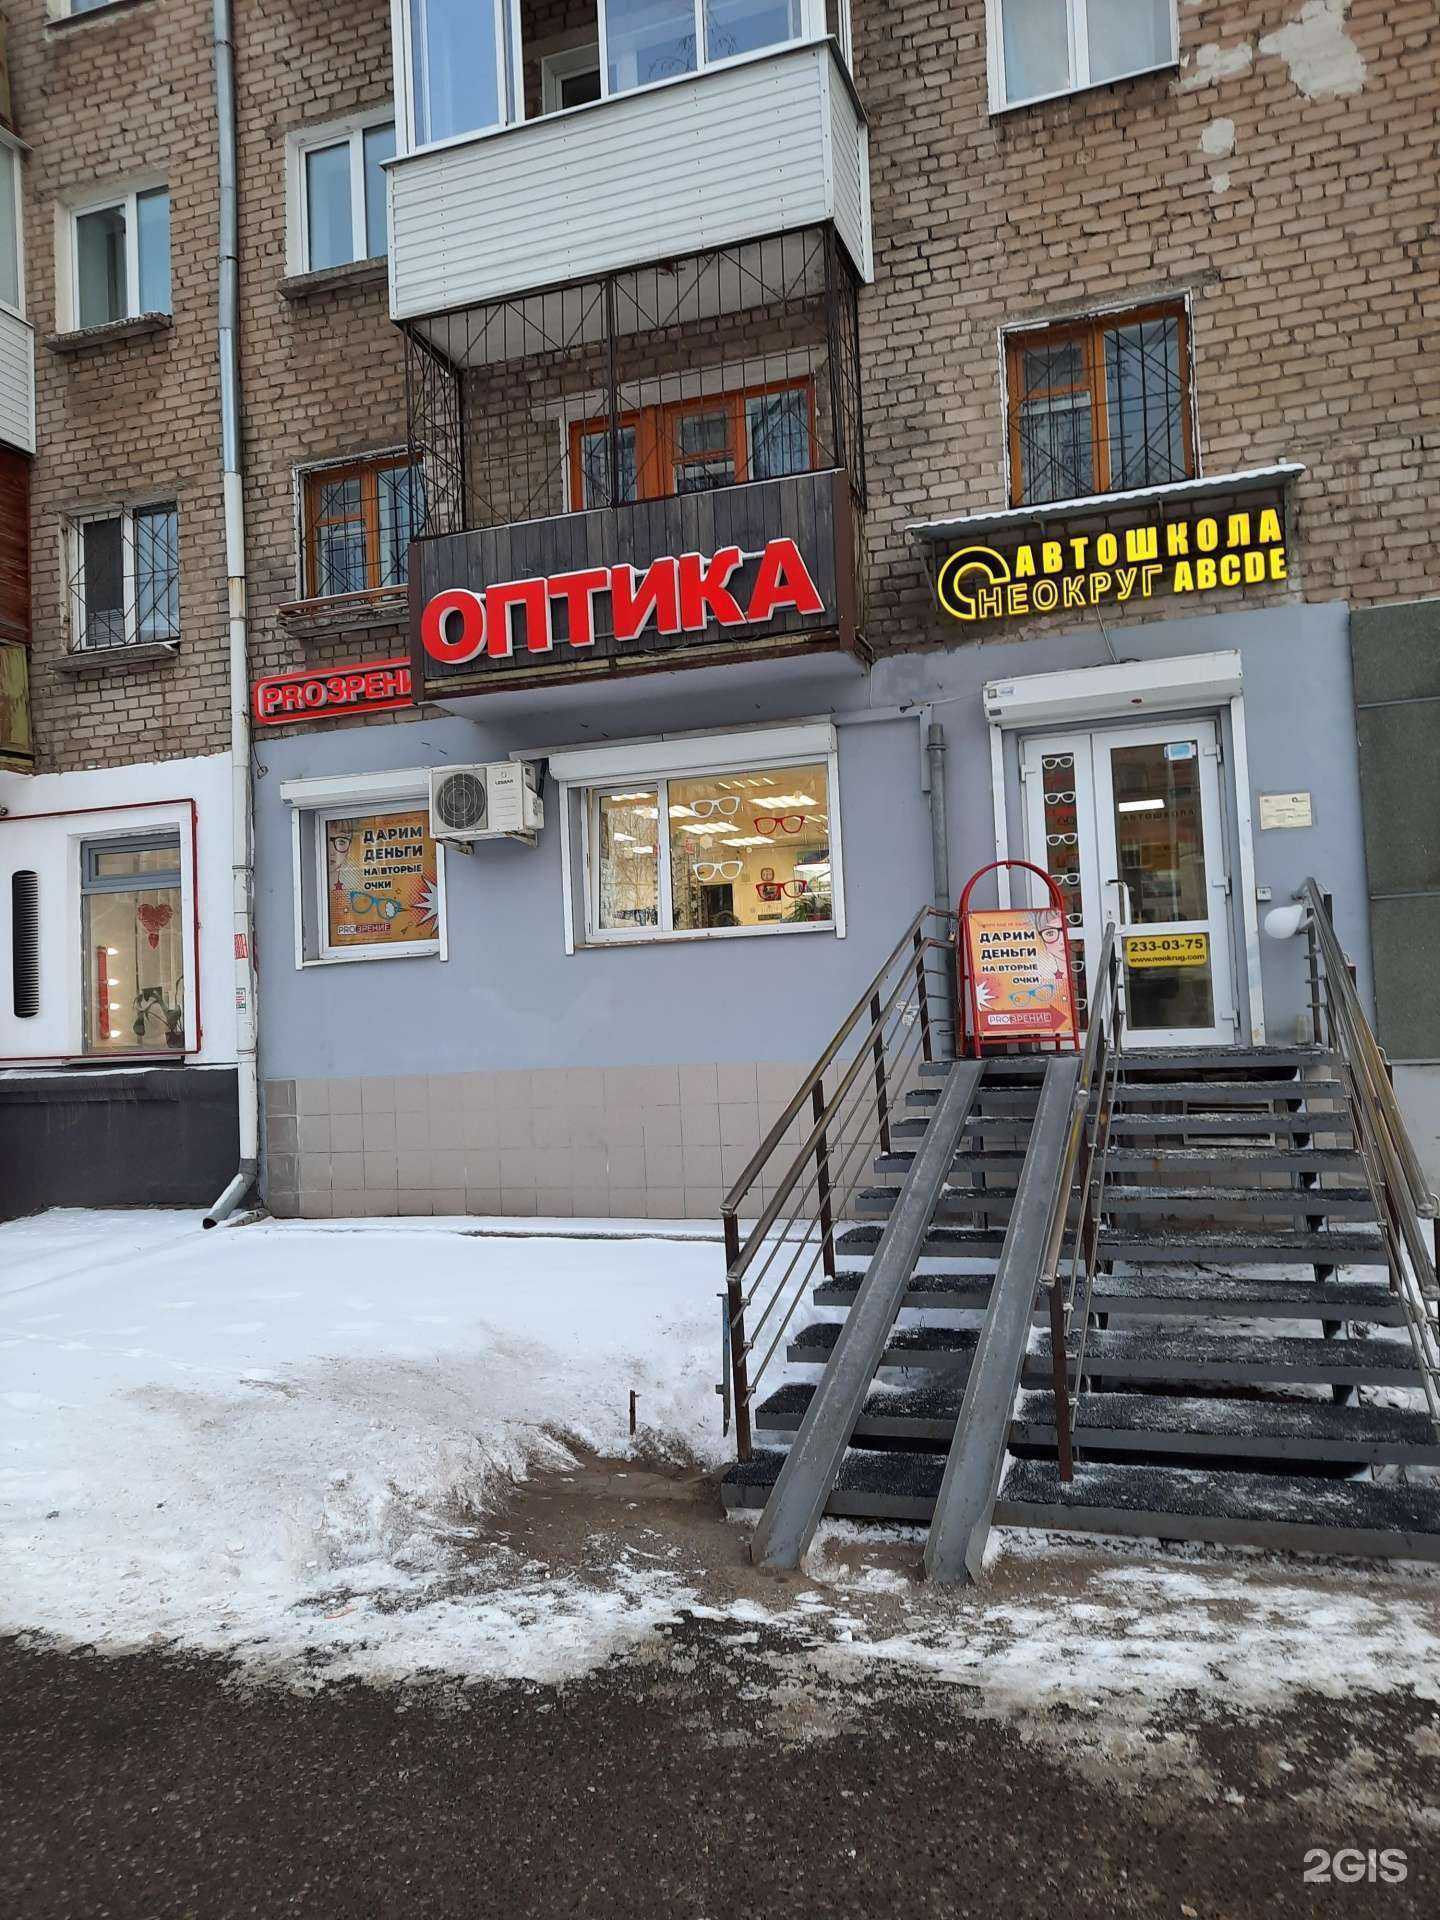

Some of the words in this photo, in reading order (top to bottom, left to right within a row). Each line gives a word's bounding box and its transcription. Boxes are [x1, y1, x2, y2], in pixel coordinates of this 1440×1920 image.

[1015, 509, 1282, 578] АВТОШКОЛА
[979, 564, 1163, 619] НЕОКРУГ
[420, 537, 825, 664] ОПТИКА
[363, 826, 423, 844] ДАРИМ
[363, 845, 423, 863] ДЕНЬГИ
[364, 867, 379, 876] НА
[381, 864, 422, 875] ВТОРЫЕ
[364, 880, 392, 890] ОЧКИ
[980, 931, 1035, 943] ДАРИМ
[1130, 938, 1204, 953] 233-03-75
[981, 948, 1036, 960] ДЕНЬГИ
[1130, 954, 1205, 963] www.neokrug.com
[998, 964, 1038, 972] ВТОРЫЕ
[1012, 976, 1040, 984] ОЧКИ
